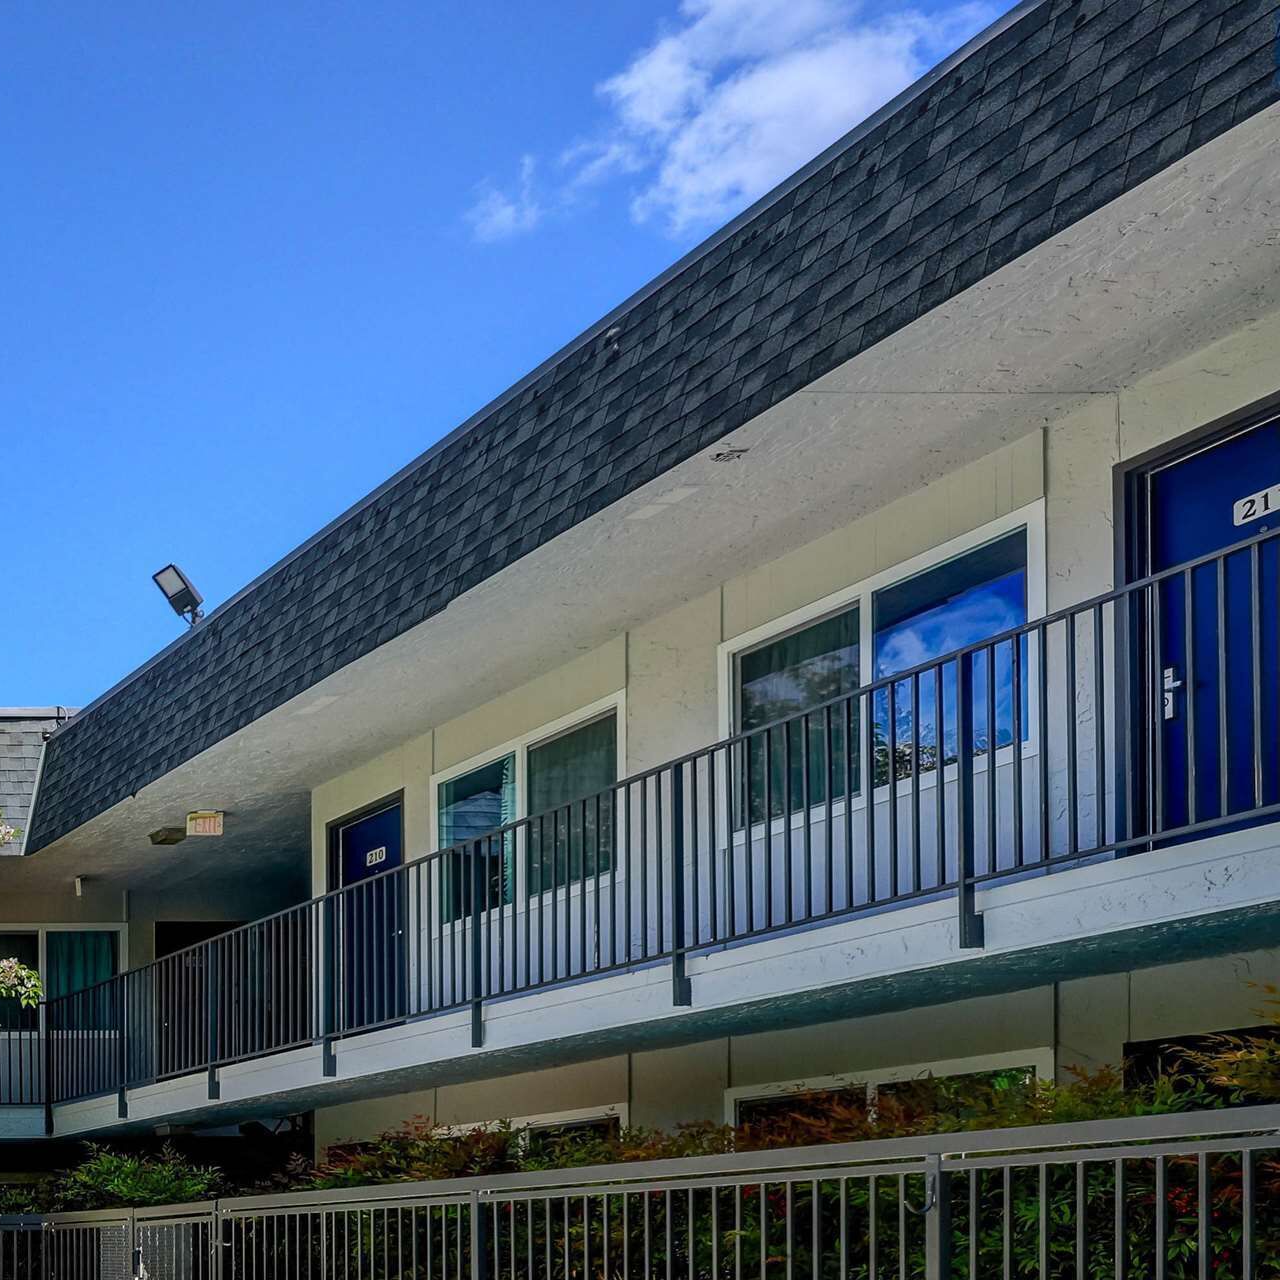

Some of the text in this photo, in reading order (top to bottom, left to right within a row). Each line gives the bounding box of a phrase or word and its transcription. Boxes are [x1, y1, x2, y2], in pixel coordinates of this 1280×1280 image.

[1242, 489, 1280, 520] 21
[194, 817, 218, 833] EXIT
[368, 849, 385, 864] 210
